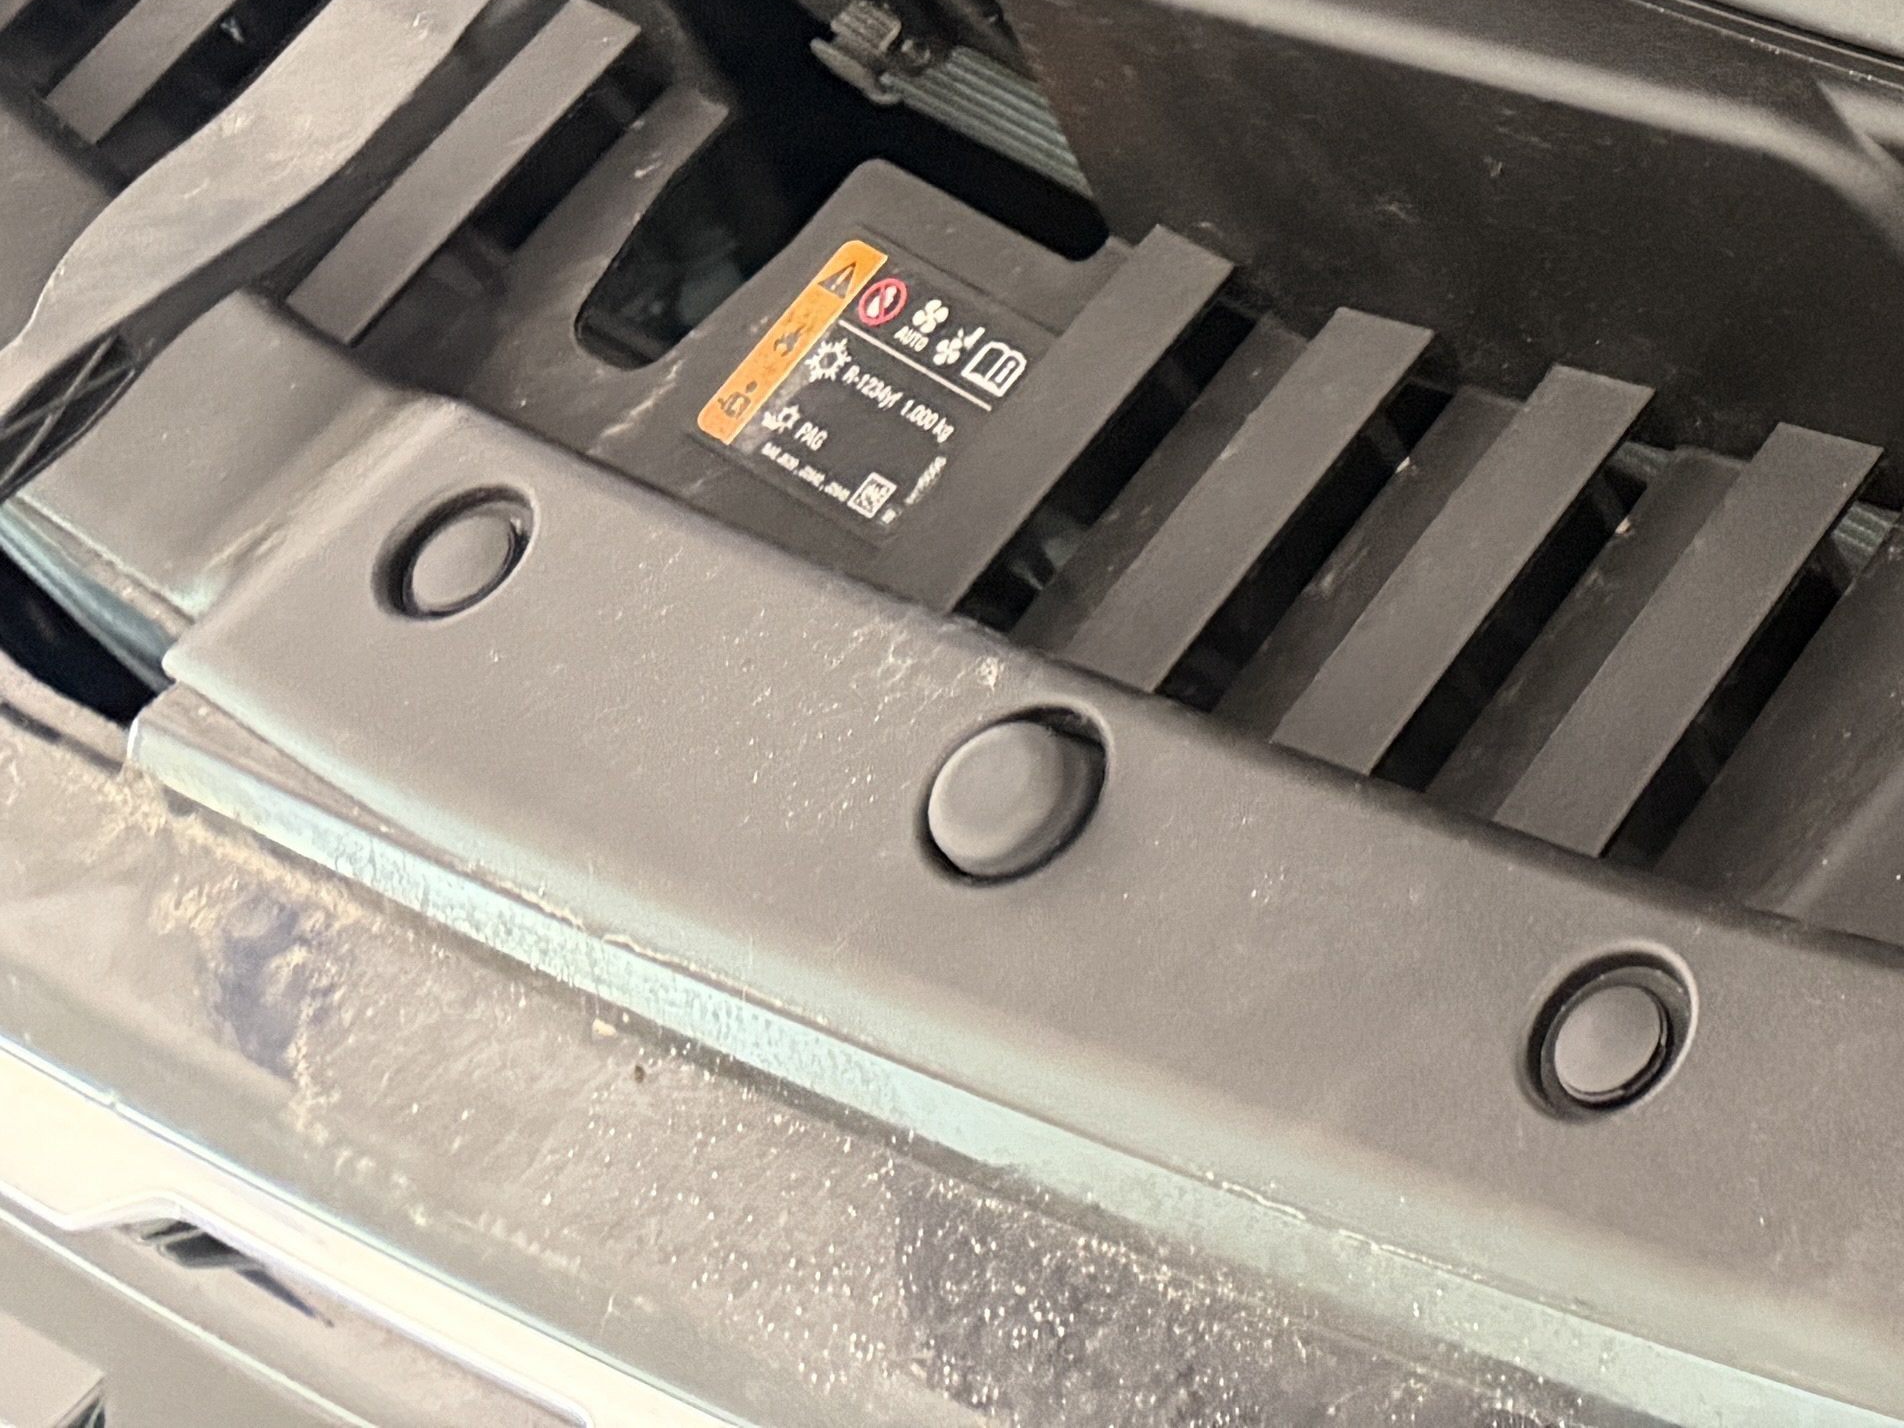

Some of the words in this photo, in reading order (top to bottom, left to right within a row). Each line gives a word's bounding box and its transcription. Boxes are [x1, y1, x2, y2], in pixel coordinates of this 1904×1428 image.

[894, 326, 929, 352] AUTO
[842, 365, 903, 410] R-1234yf
[794, 422, 828, 451] PAG
